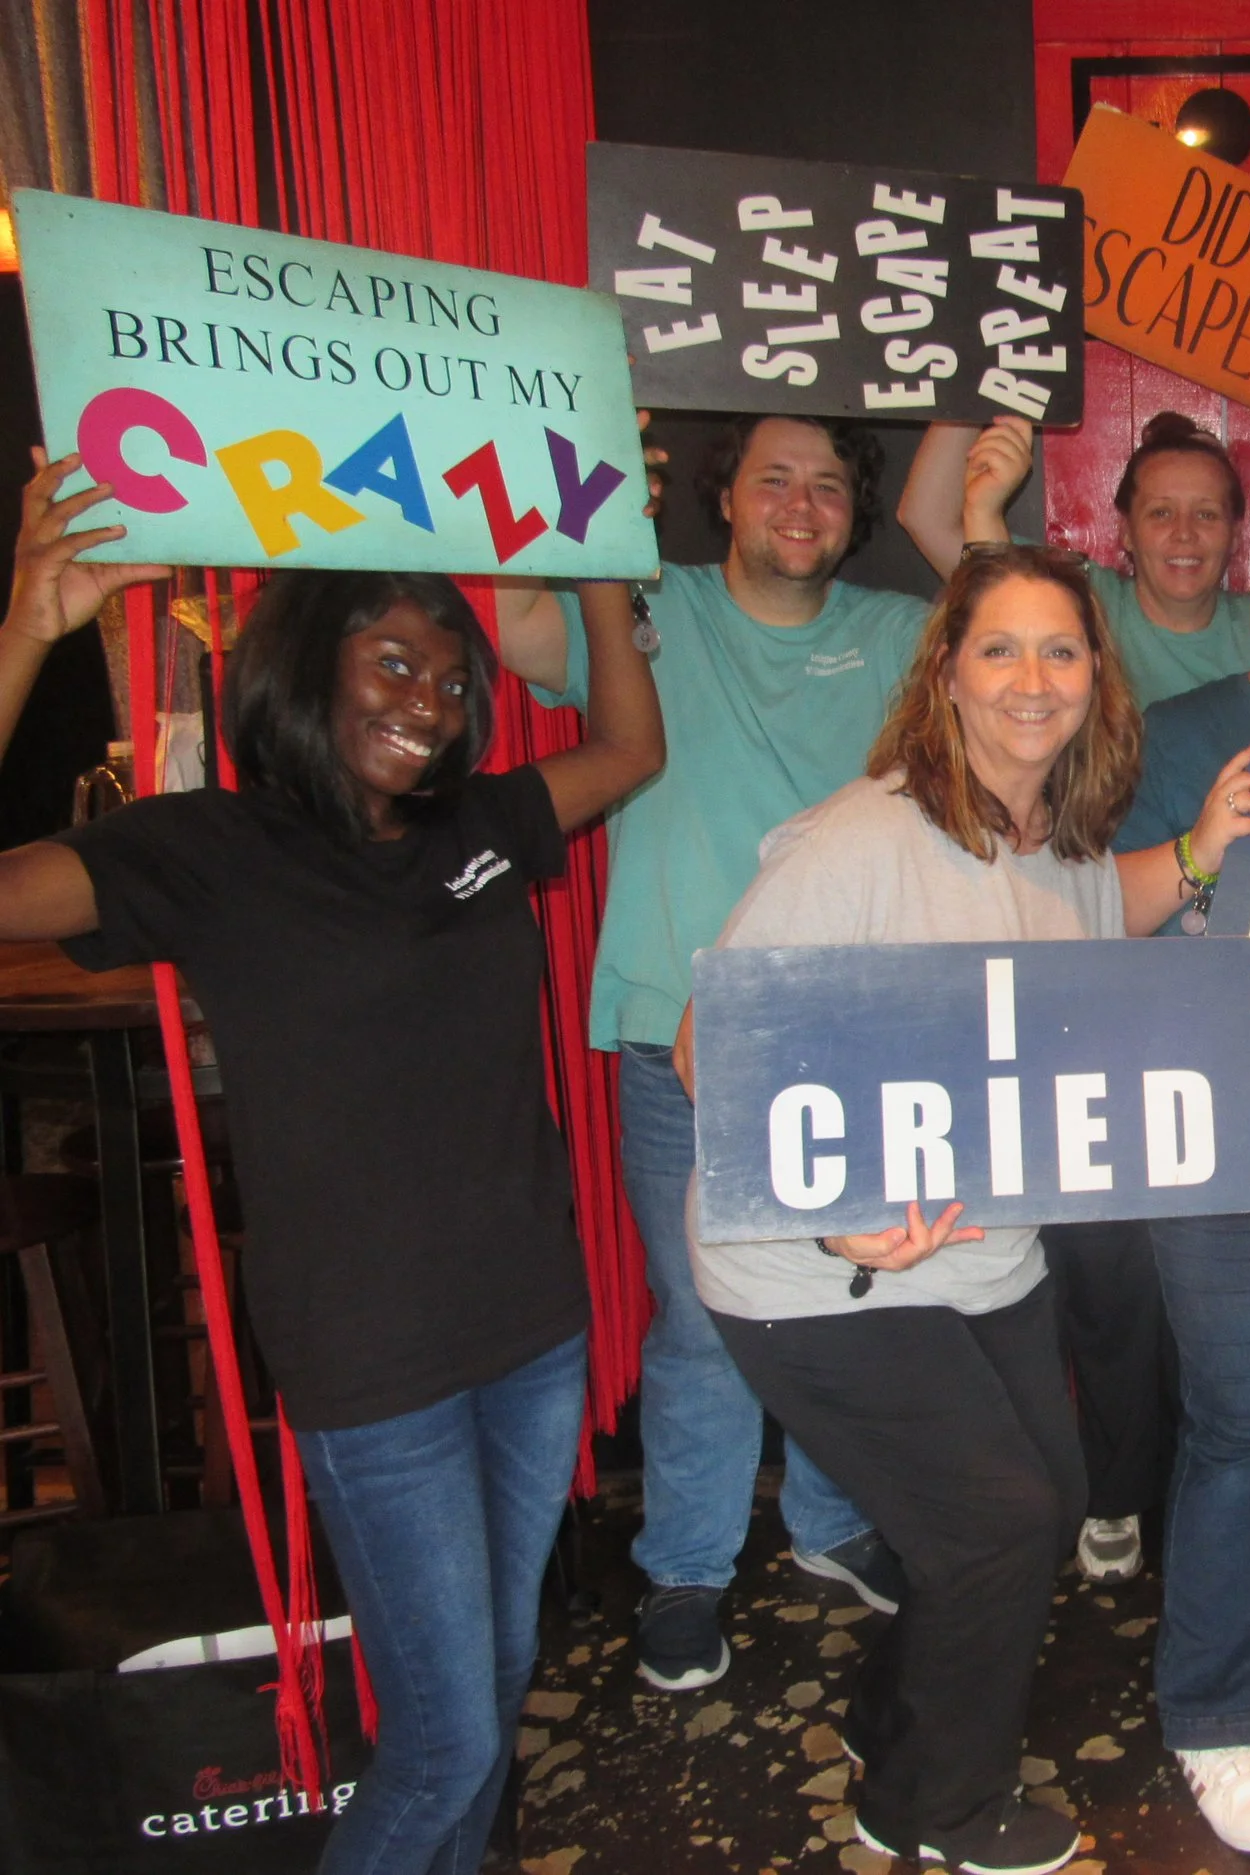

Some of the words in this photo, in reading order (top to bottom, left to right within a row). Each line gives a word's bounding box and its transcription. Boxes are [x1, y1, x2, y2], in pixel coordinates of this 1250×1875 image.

[200, 247, 502, 336] ESCAPING
[615, 213, 722, 353] EAT
[737, 195, 840, 386] SLEEP
[854, 183, 958, 409] ESCAPE
[968, 188, 1068, 420] REPEAT
[103, 308, 357, 384] BRINGS
[375, 346, 487, 401] OUT
[505, 364, 583, 412] MY
[77, 387, 628, 565] CRAZY
[986, 958, 1016, 1060] I
[769, 1070, 1216, 1210] CRIED
[141, 1780, 357, 1837] catering
